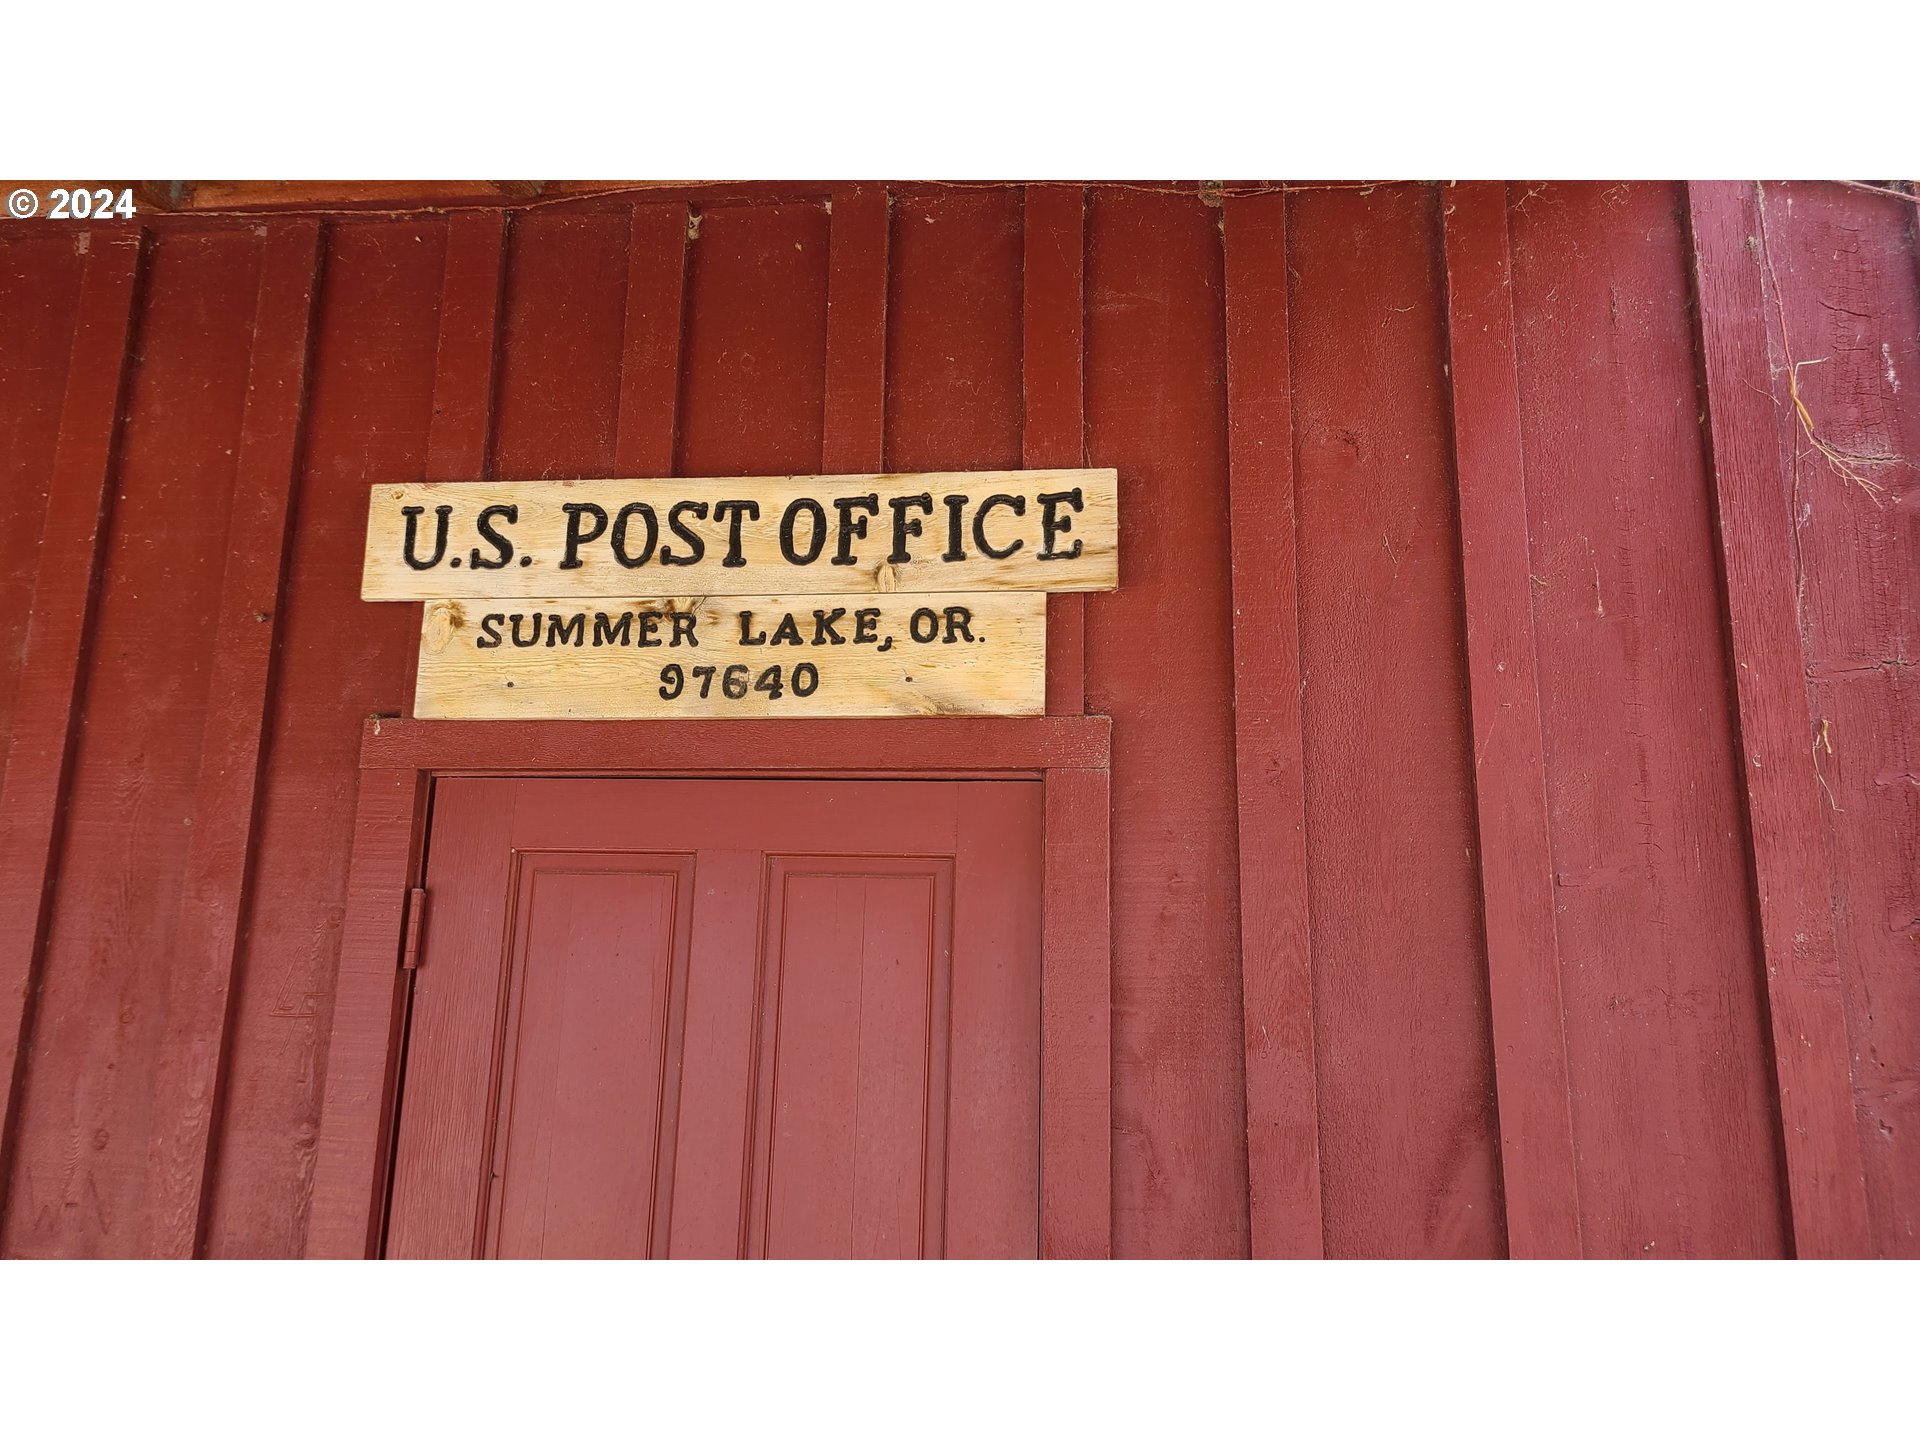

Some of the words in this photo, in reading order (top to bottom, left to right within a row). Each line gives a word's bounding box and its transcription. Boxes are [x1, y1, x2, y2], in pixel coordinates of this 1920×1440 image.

[400, 503, 533, 571] U.S.
[558, 498, 761, 570] POST
[779, 486, 1085, 566] OFFICE
[476, 610, 700, 649] SUMMER
[738, 606, 894, 652] LAKE,
[909, 605, 987, 645] OR.
[658, 661, 820, 701] 97640
